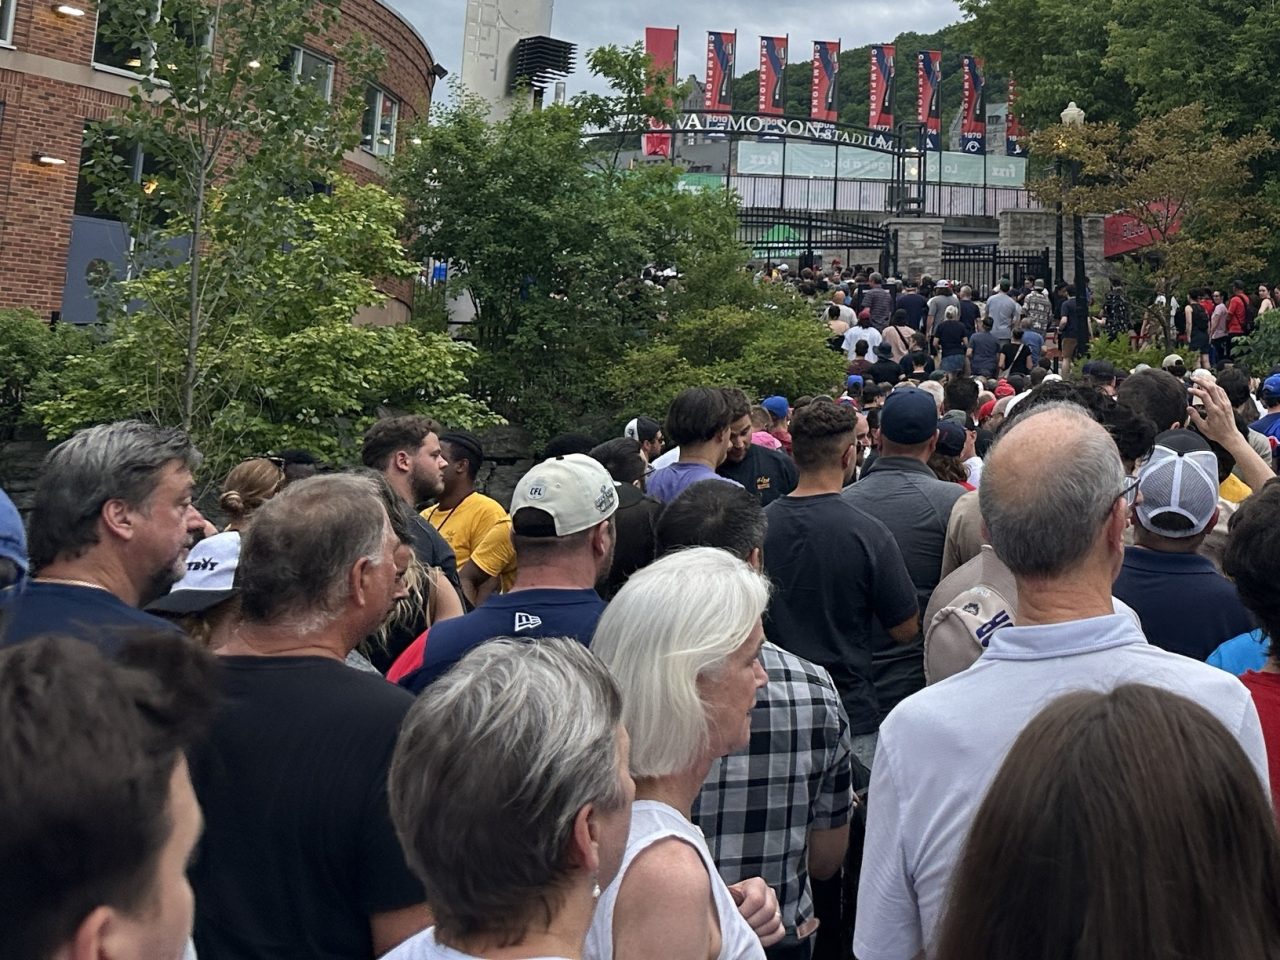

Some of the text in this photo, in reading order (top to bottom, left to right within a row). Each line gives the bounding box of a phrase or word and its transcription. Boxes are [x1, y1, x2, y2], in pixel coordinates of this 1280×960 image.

[705, 34, 715, 107] CHAMPIONS
[759, 40, 768, 110] CHAMPIONS
[812, 44, 821, 114] CHAMPIONS
[870, 49, 878, 117] CHAMPIONS
[727, 114, 821, 139] MOLSON
[824, 129, 893, 150] STADIUM
[529, 487, 542, 496] CFL
